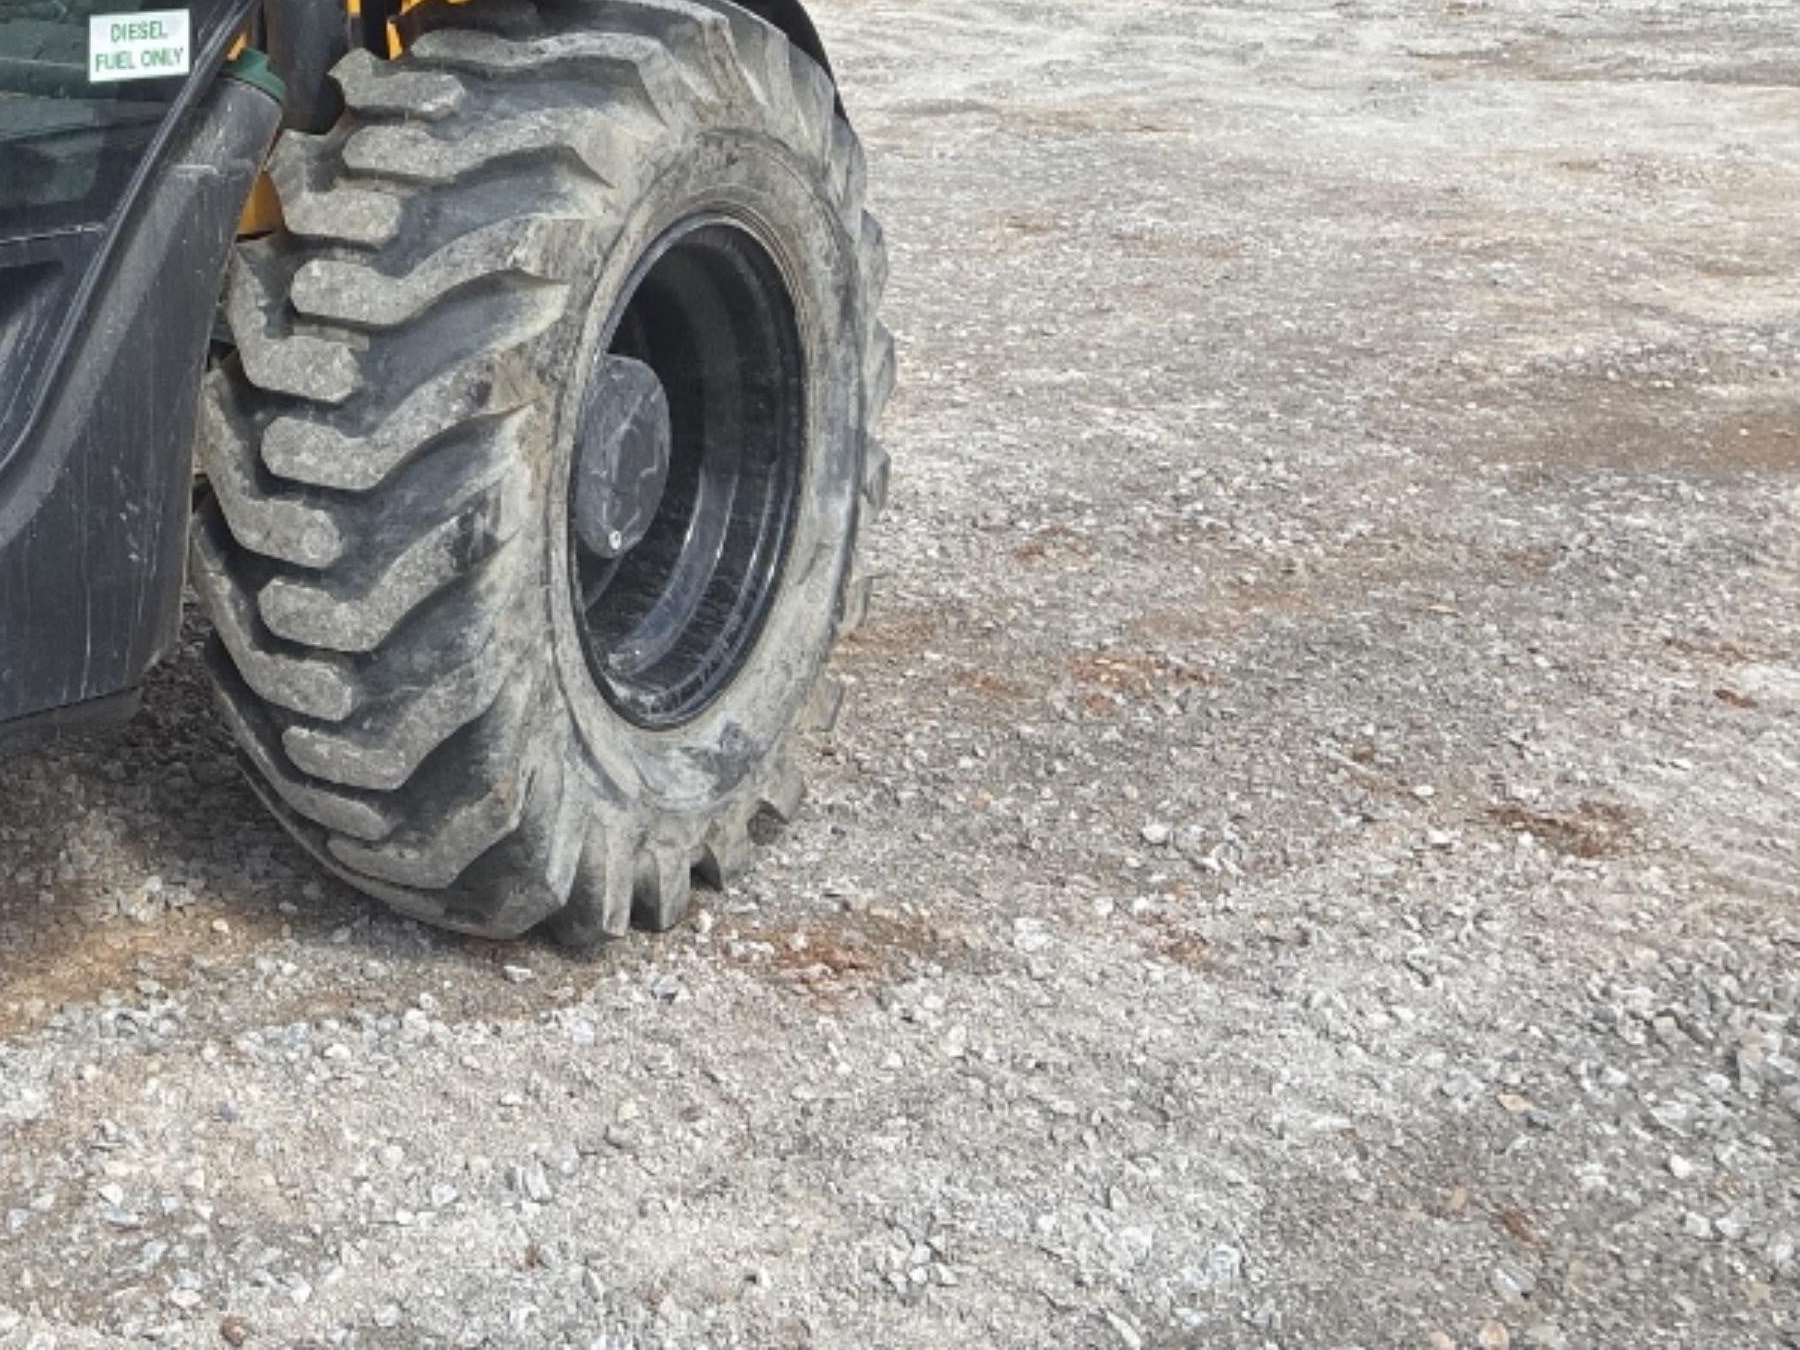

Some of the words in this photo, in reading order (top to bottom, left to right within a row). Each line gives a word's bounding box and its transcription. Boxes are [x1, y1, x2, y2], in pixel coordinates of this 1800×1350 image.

[111, 21, 168, 43] DIESEL
[95, 51, 136, 72] FUEL
[142, 47, 185, 68] ONLY
